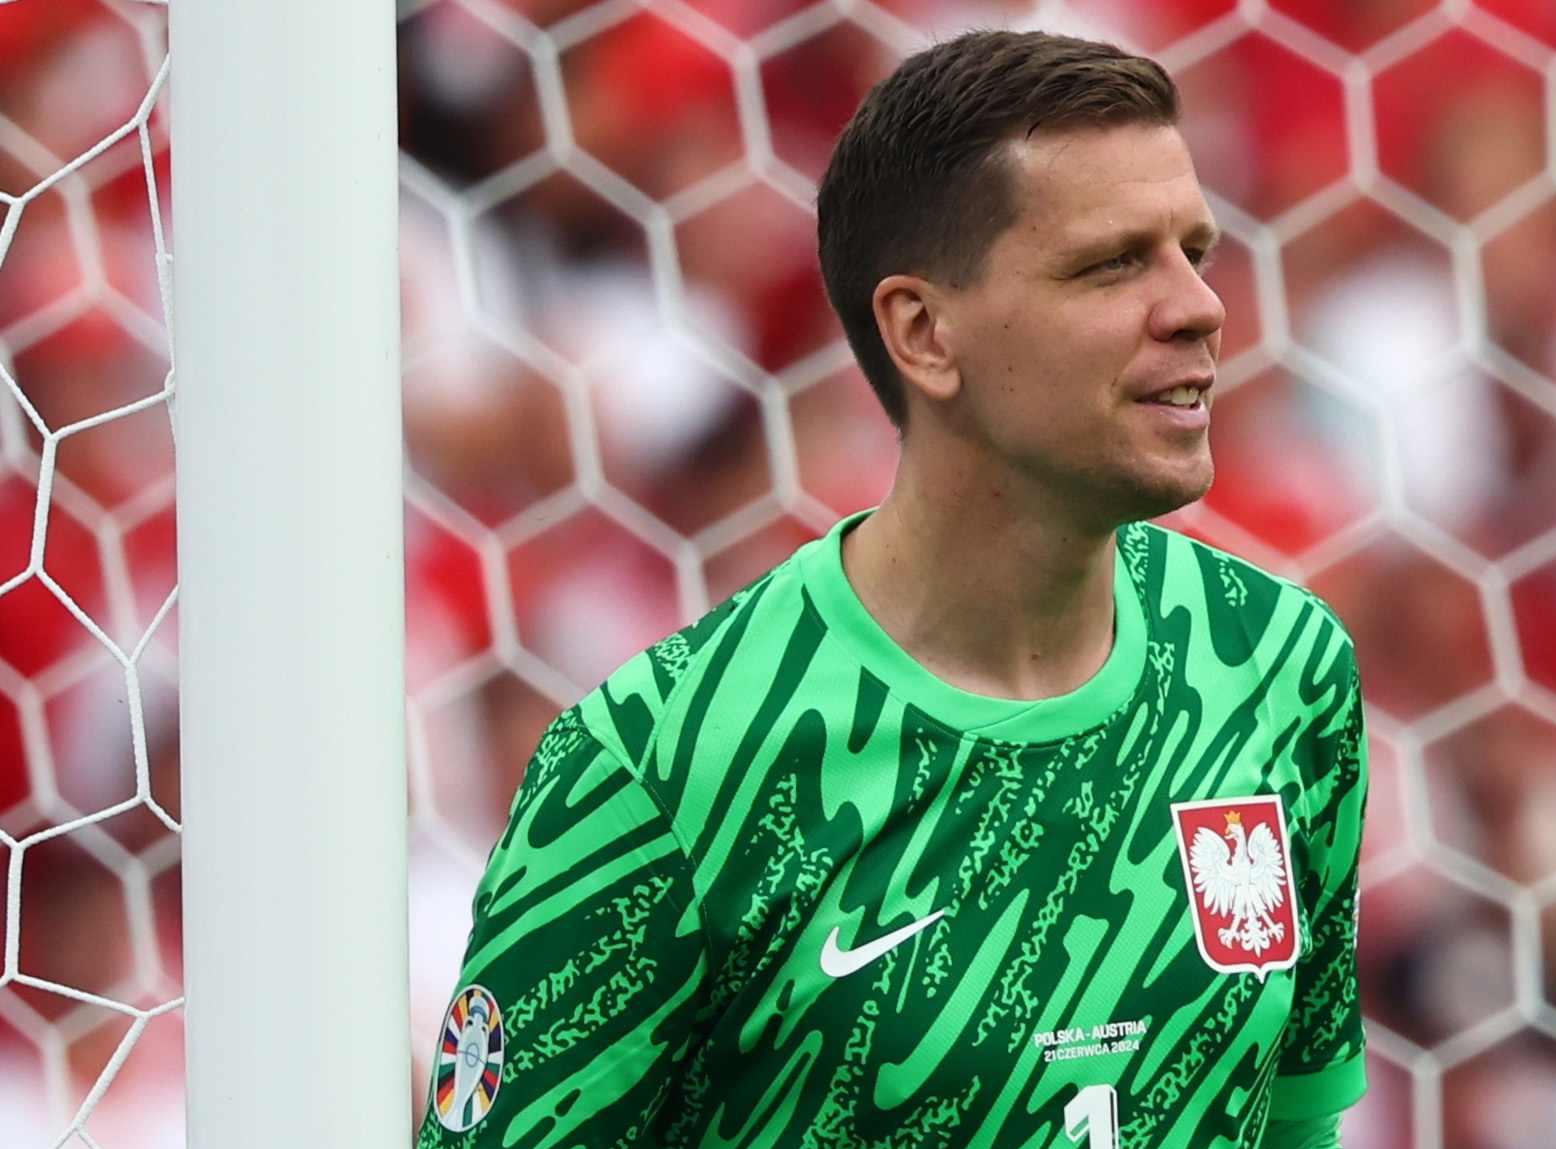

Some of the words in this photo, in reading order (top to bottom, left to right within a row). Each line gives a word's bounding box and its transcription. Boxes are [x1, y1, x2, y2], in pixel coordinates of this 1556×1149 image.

[1034, 1028, 1085, 1047] POLSKA
[1092, 1020, 1147, 1040] AUSTRIA
[1044, 1050, 1056, 1062] 21
[1057, 1043, 1110, 1060] CZERWCA
[1111, 1039, 1140, 1053] 2024
